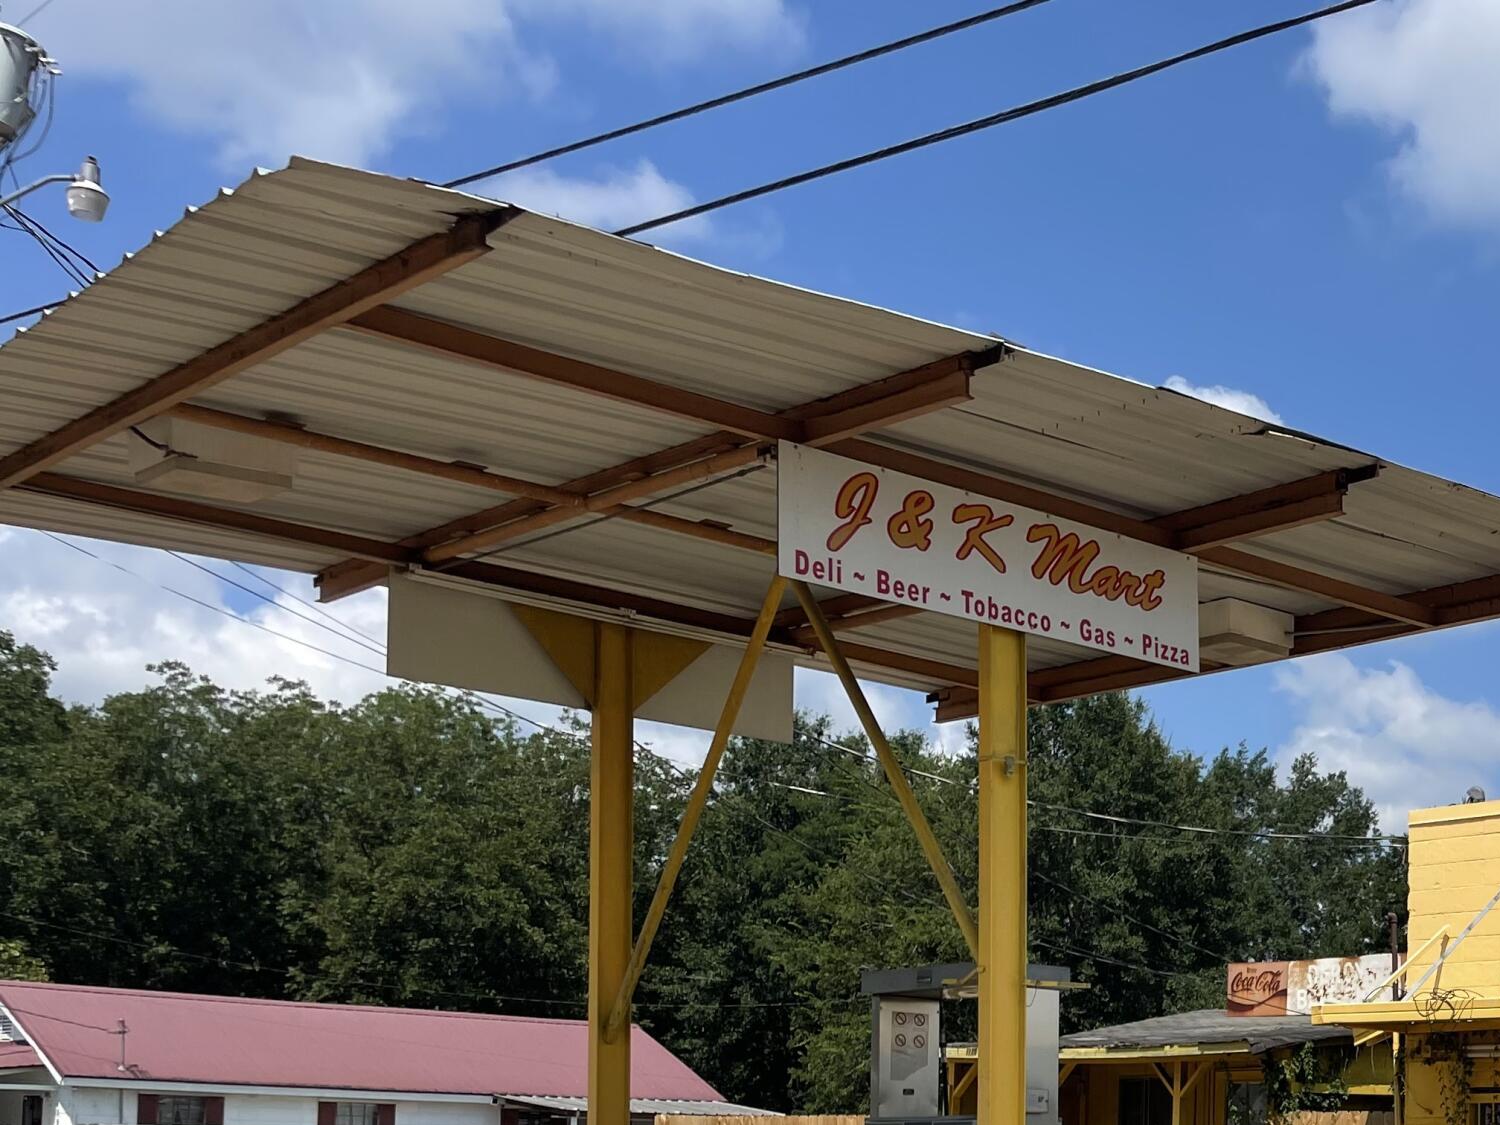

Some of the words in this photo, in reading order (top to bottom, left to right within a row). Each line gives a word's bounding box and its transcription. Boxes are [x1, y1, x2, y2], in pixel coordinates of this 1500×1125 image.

[827, 472, 878, 552] J
[887, 490, 935, 551] &
[952, 504, 1014, 573] K
[1026, 523, 1165, 611] Mart
[795, 550, 842, 584] Deli
[877, 569, 930, 604] Beer
[961, 590, 1050, 632] Tobacco
[1080, 619, 1116, 647] Gas
[1142, 634, 1190, 666] Pizza
